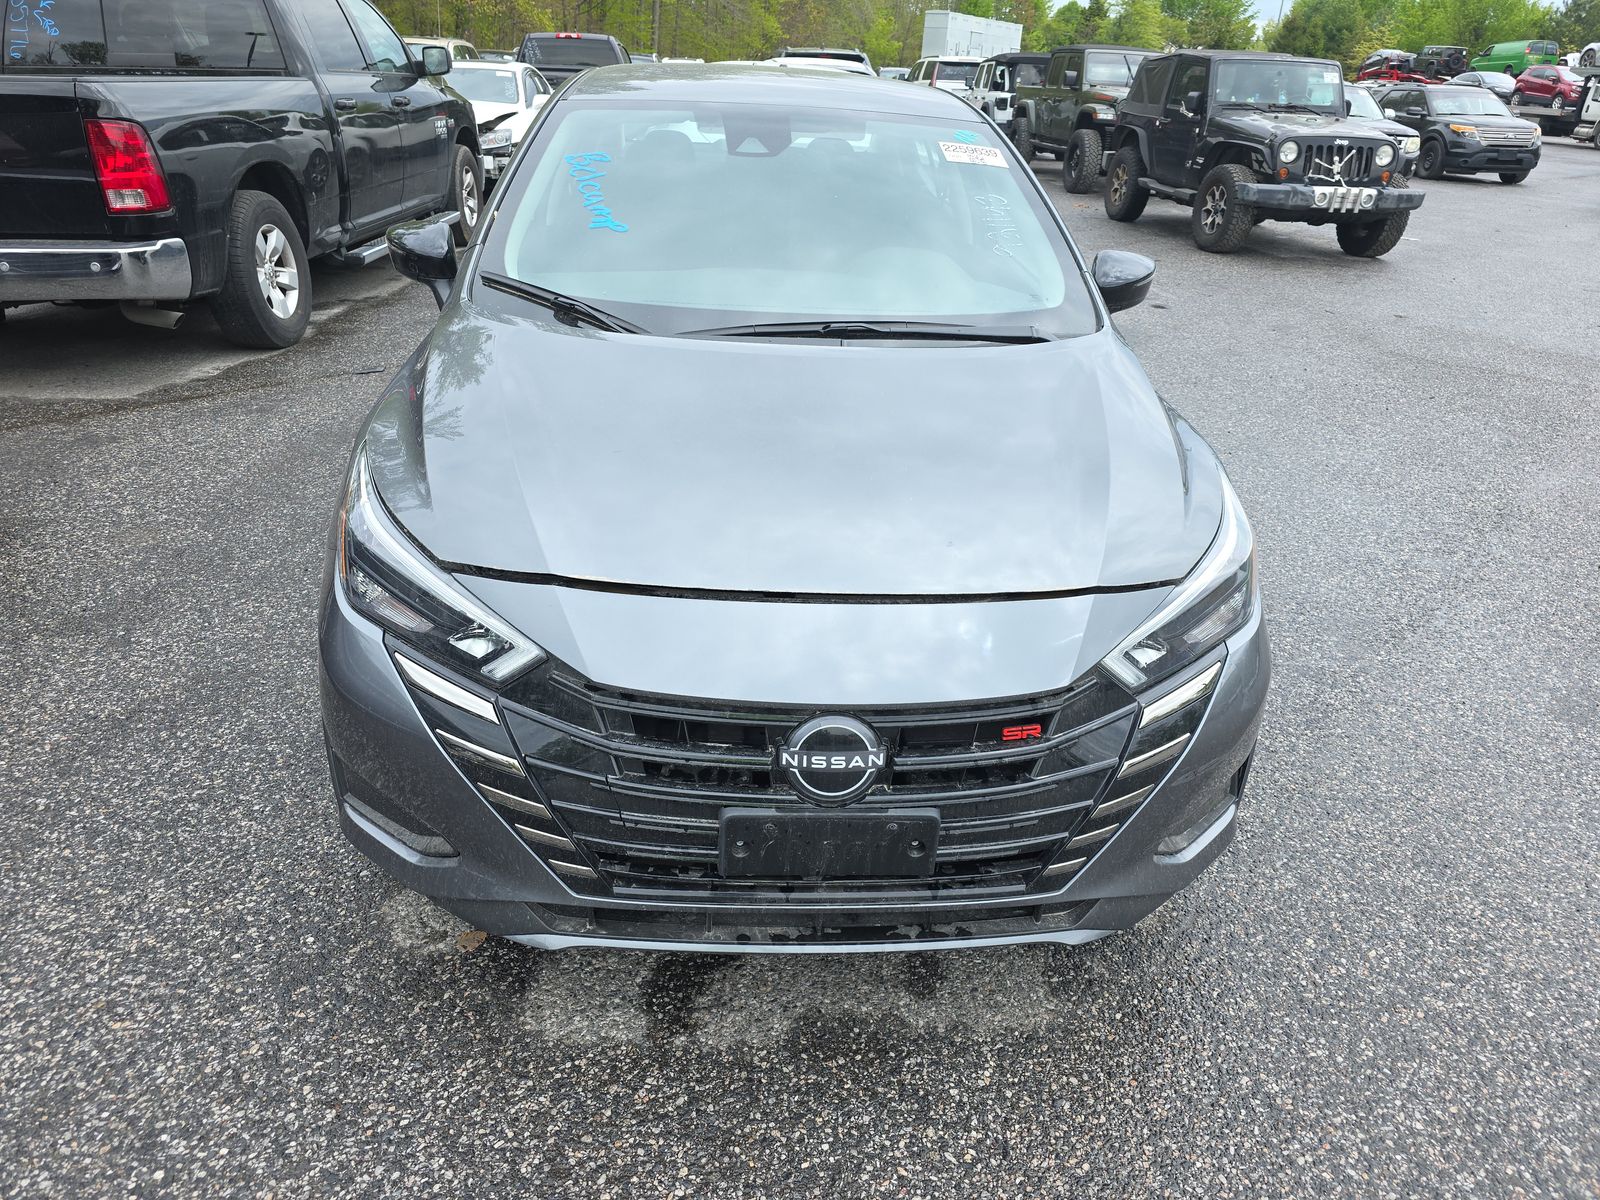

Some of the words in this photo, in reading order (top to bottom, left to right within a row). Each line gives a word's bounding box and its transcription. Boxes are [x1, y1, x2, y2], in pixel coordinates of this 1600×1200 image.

[1333, 138, 1349, 146] Jeep
[942, 143, 998, 158] 2259639
[1002, 723, 1042, 741] SR
[781, 752, 884, 769] NISSAN
